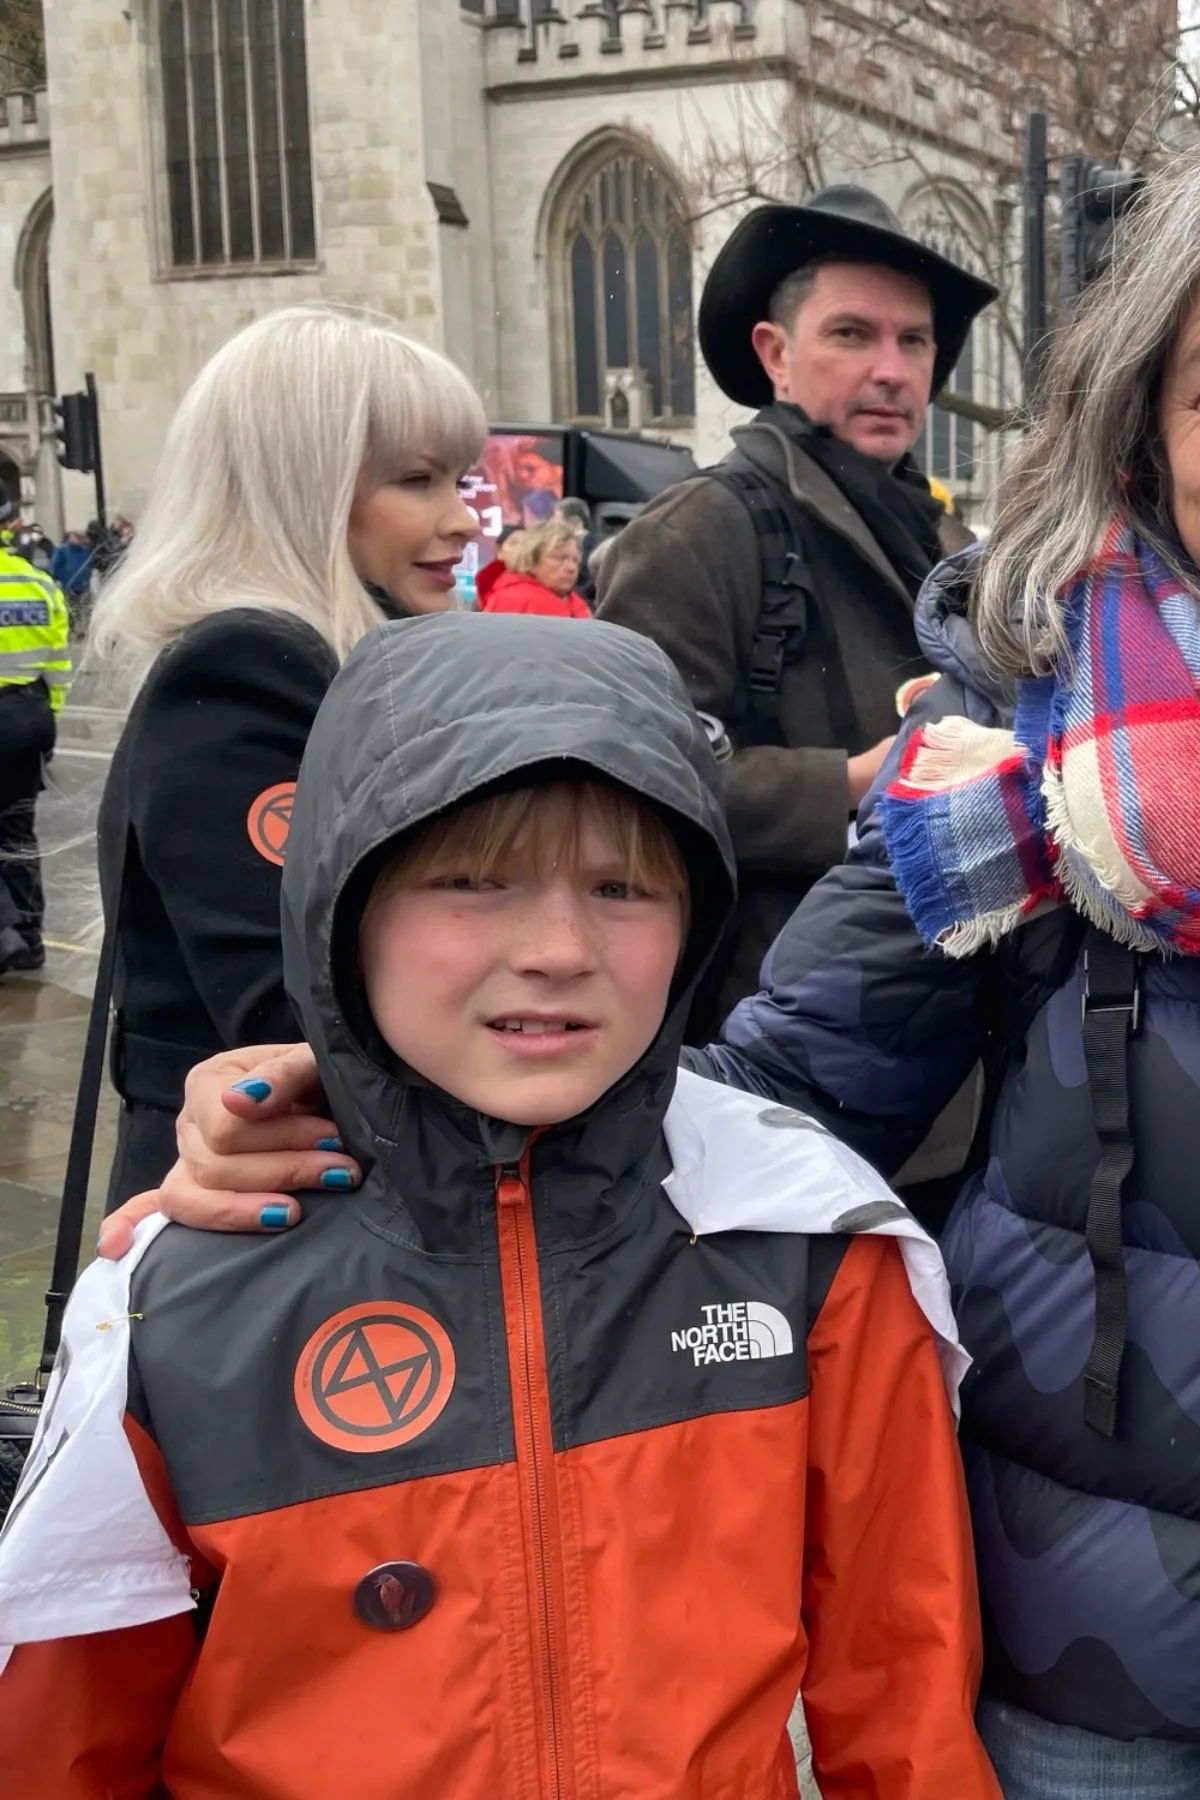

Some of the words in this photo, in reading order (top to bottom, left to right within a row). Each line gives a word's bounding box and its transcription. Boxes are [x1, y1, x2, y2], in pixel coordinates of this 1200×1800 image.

[0, 609, 48, 626] OLICE
[701, 1302, 746, 1325] THE
[671, 1321, 748, 1352] NORTH
[693, 1341, 750, 1367] FACE
